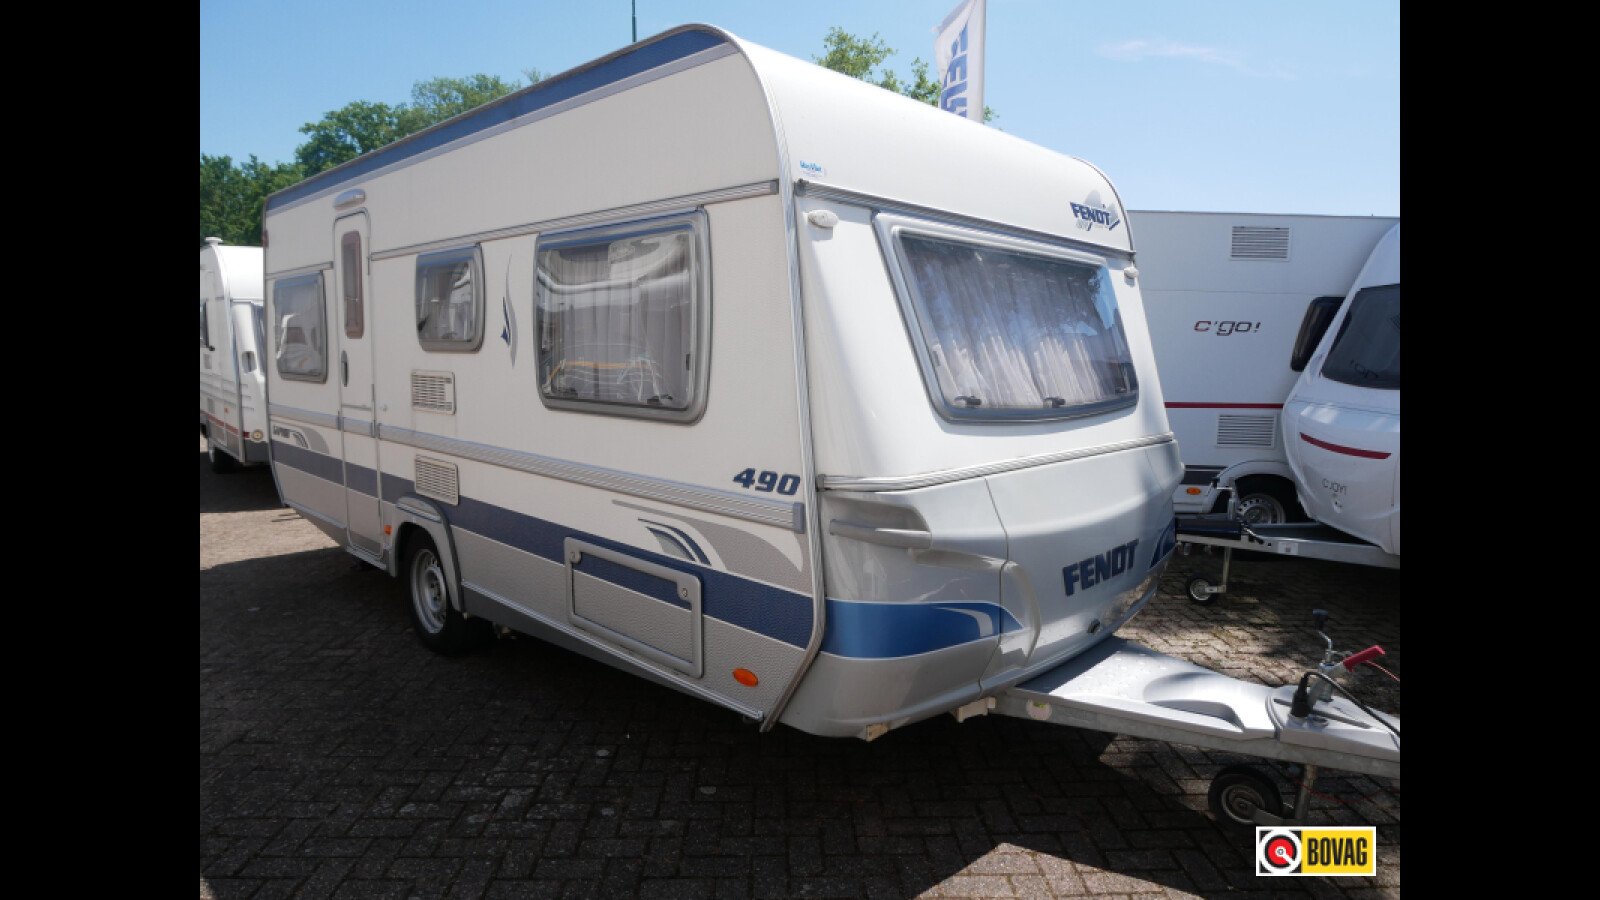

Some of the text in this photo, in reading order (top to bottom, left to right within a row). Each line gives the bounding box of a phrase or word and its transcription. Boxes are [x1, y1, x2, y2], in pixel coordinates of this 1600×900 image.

[1070, 202, 1110, 226] FENDT
[733, 467, 801, 496] 490
[1062, 538, 1139, 597] FENDT
